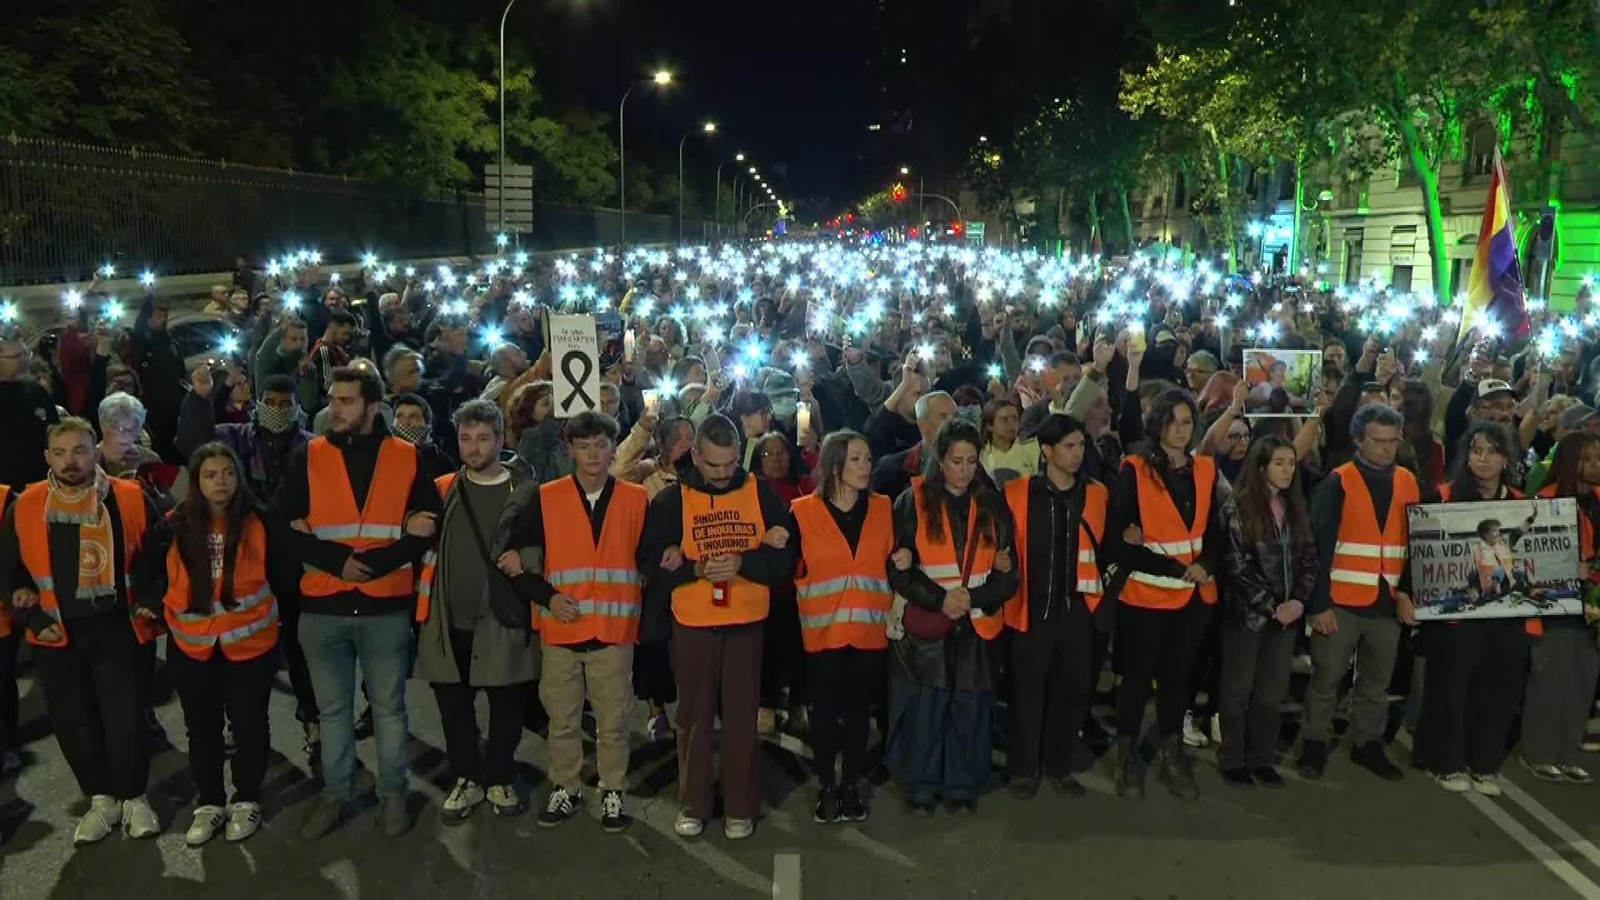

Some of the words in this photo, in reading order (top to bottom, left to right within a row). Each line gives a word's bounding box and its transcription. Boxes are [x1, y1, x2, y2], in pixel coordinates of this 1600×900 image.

[693, 510, 740, 526] SINDICATO
[694, 527, 707, 539] DE
[707, 524, 754, 537] INQUILINAS
[697, 543, 703, 553] E
[703, 538, 749, 550] INQUILINOS
[1441, 541, 1471, 558] VIDA
[1523, 536, 1571, 554] BARRIO
